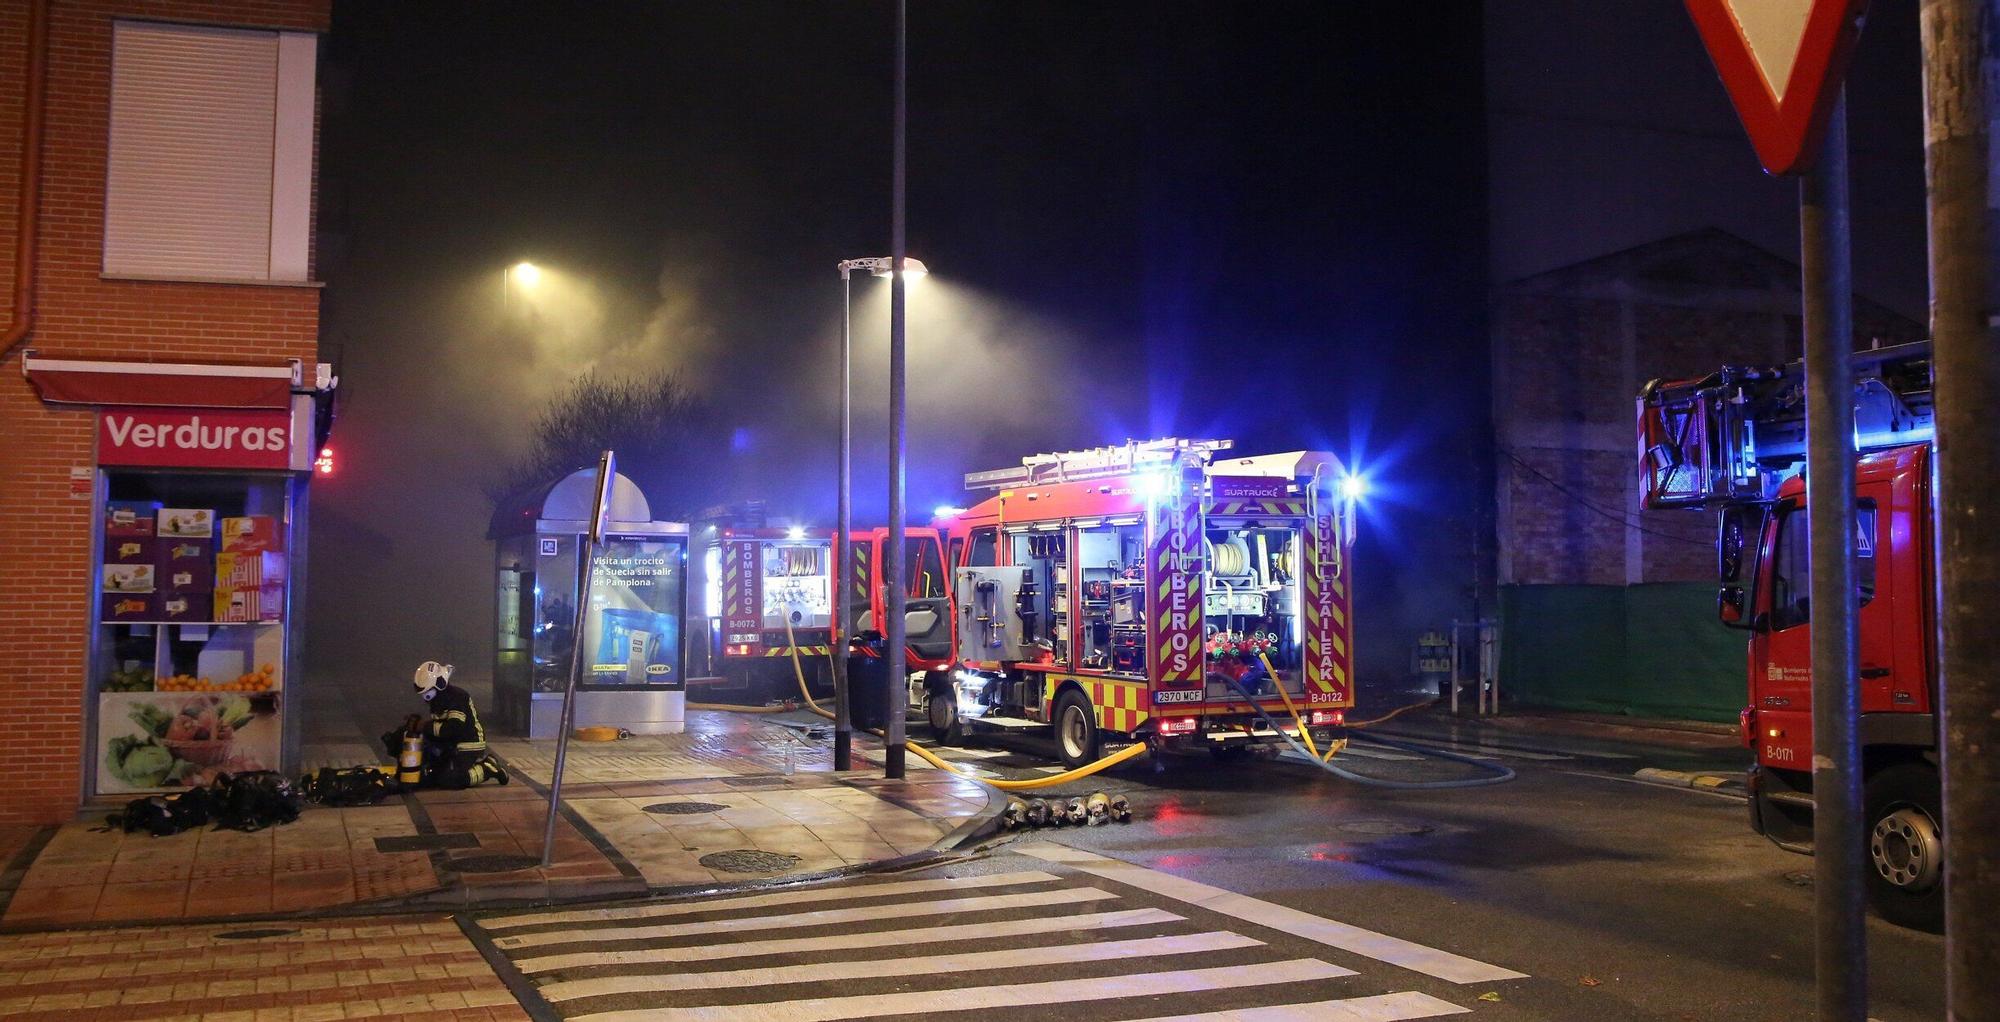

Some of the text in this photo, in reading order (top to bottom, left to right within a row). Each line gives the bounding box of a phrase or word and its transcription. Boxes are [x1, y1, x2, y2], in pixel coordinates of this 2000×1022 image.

[105, 415, 285, 451] Verduras
[1224, 487, 1279, 497] SURTRUCK
[593, 557, 618, 565] Visita
[634, 557, 665, 565] trocito
[593, 568, 672, 576] de Suecia sin salir
[593, 578, 604, 586] de
[743, 543, 753, 614] BOMBEROS
[1170, 511, 1188, 672] BOMBEROS
[1318, 516, 1333, 681] SUHILTZAILEAK
[729, 620, 755, 628] B-0072
[1159, 691, 1200, 701] 2970 MCF
[1311, 693, 1343, 702] B-0122
[1767, 746, 1794, 761] B-0171
